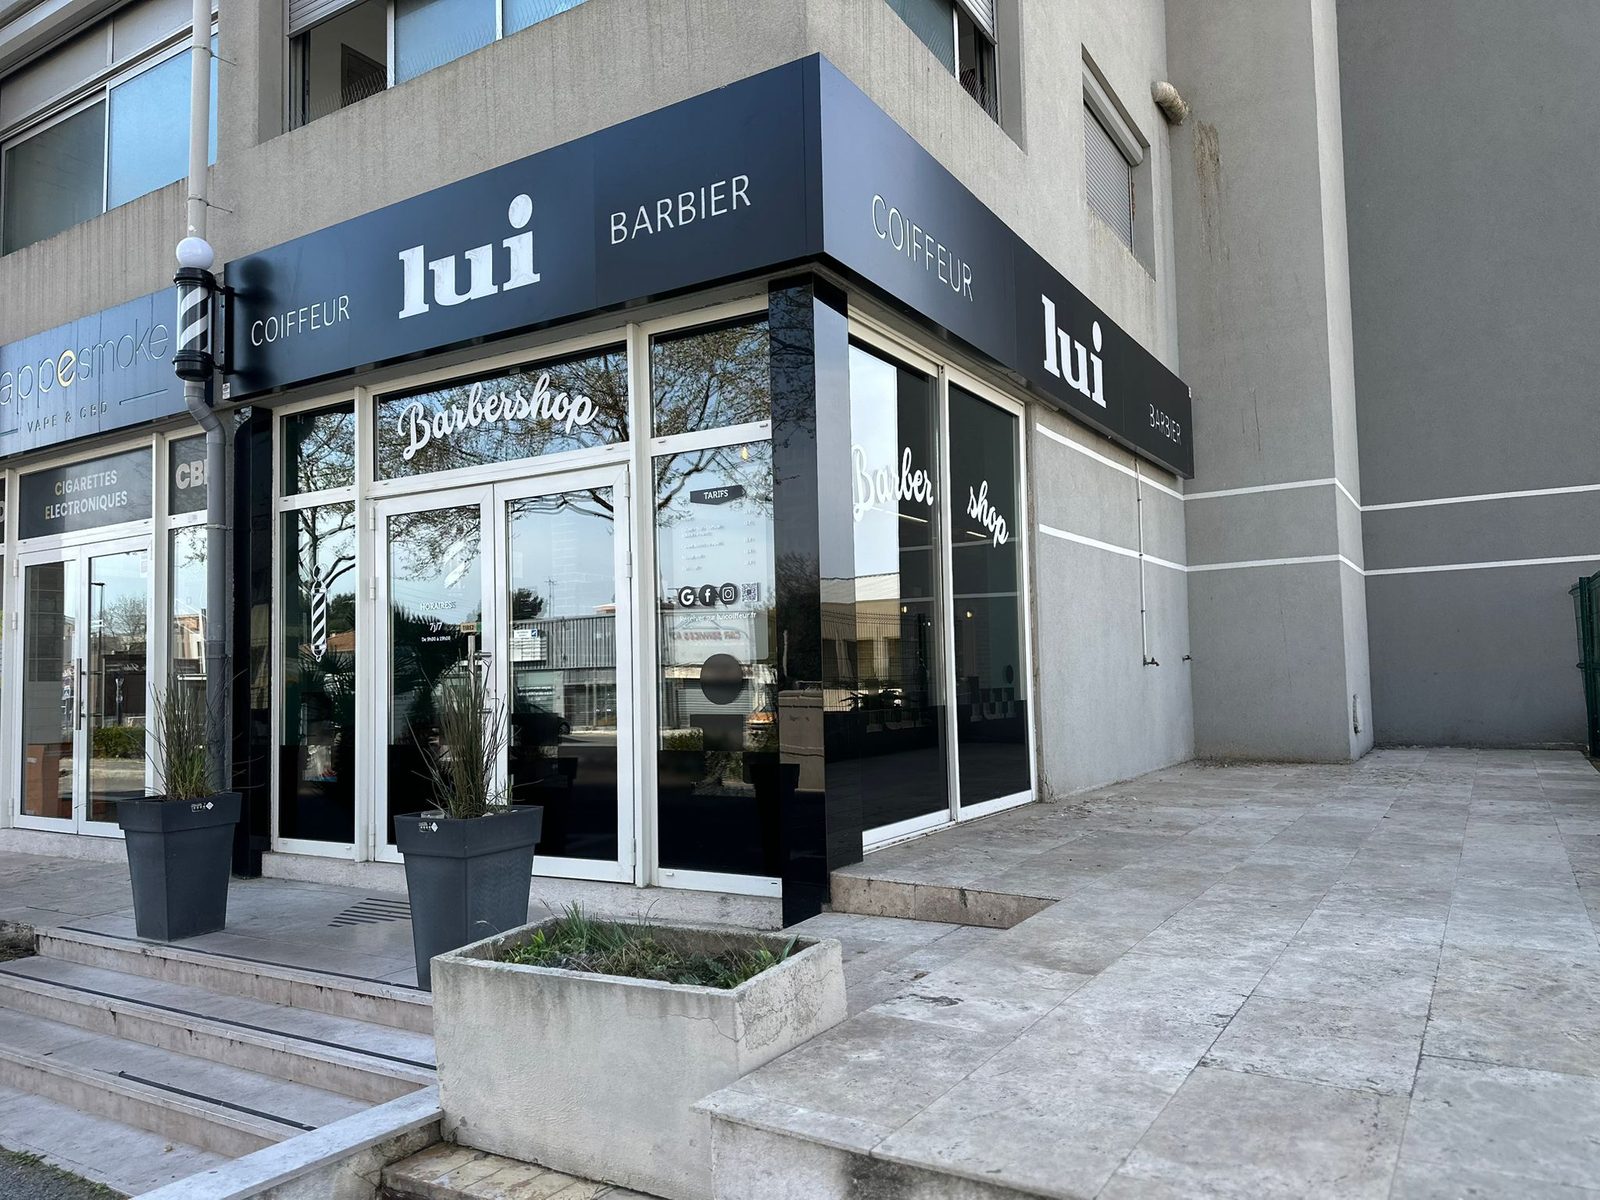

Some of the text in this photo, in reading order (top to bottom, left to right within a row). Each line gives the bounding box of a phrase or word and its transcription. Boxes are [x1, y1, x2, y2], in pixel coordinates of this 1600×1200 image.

[610, 174, 751, 245] BARBIER
[399, 193, 540, 319] lui
[872, 194, 974, 302] COIFFEUR
[251, 295, 350, 346] COIFFEUR
[1041, 293, 1107, 409] lui
[27, 401, 108, 433] VAPE & CBD
[398, 373, 599, 461] Barbershop
[1149, 403, 1182, 446] BARBIER
[44, 490, 128, 520] ELECTRONIQUES
[54, 469, 118, 496] CIGARETTES
[704, 489, 729, 500] TARIFS
[851, 443, 934, 523] Barber
[966, 480, 1009, 548] shop
[681, 589, 694, 606] G
